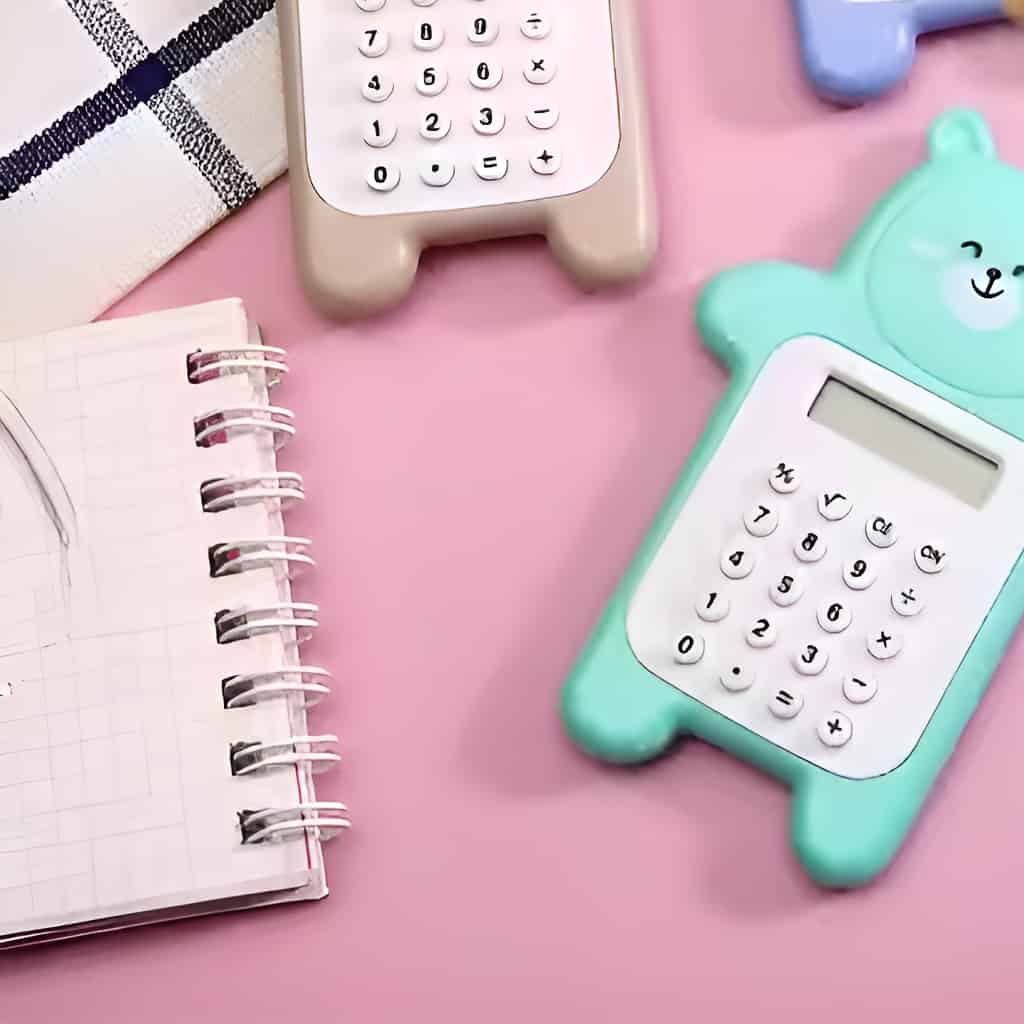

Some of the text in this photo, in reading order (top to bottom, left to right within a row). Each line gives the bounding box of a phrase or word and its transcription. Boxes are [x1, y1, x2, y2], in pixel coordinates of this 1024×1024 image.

[364, 29, 378, 47] 7
[425, 112, 441, 132] 2
[479, 107, 493, 126] 3
[373, 165, 388, 184] 0
[752, 505, 771, 523] 7
[849, 559, 868, 578] 9
[776, 575, 795, 594] 5
[826, 602, 844, 622] 6
[677, 634, 695, 655] 0
[751, 618, 771, 638] 2
[801, 644, 819, 664] 3
